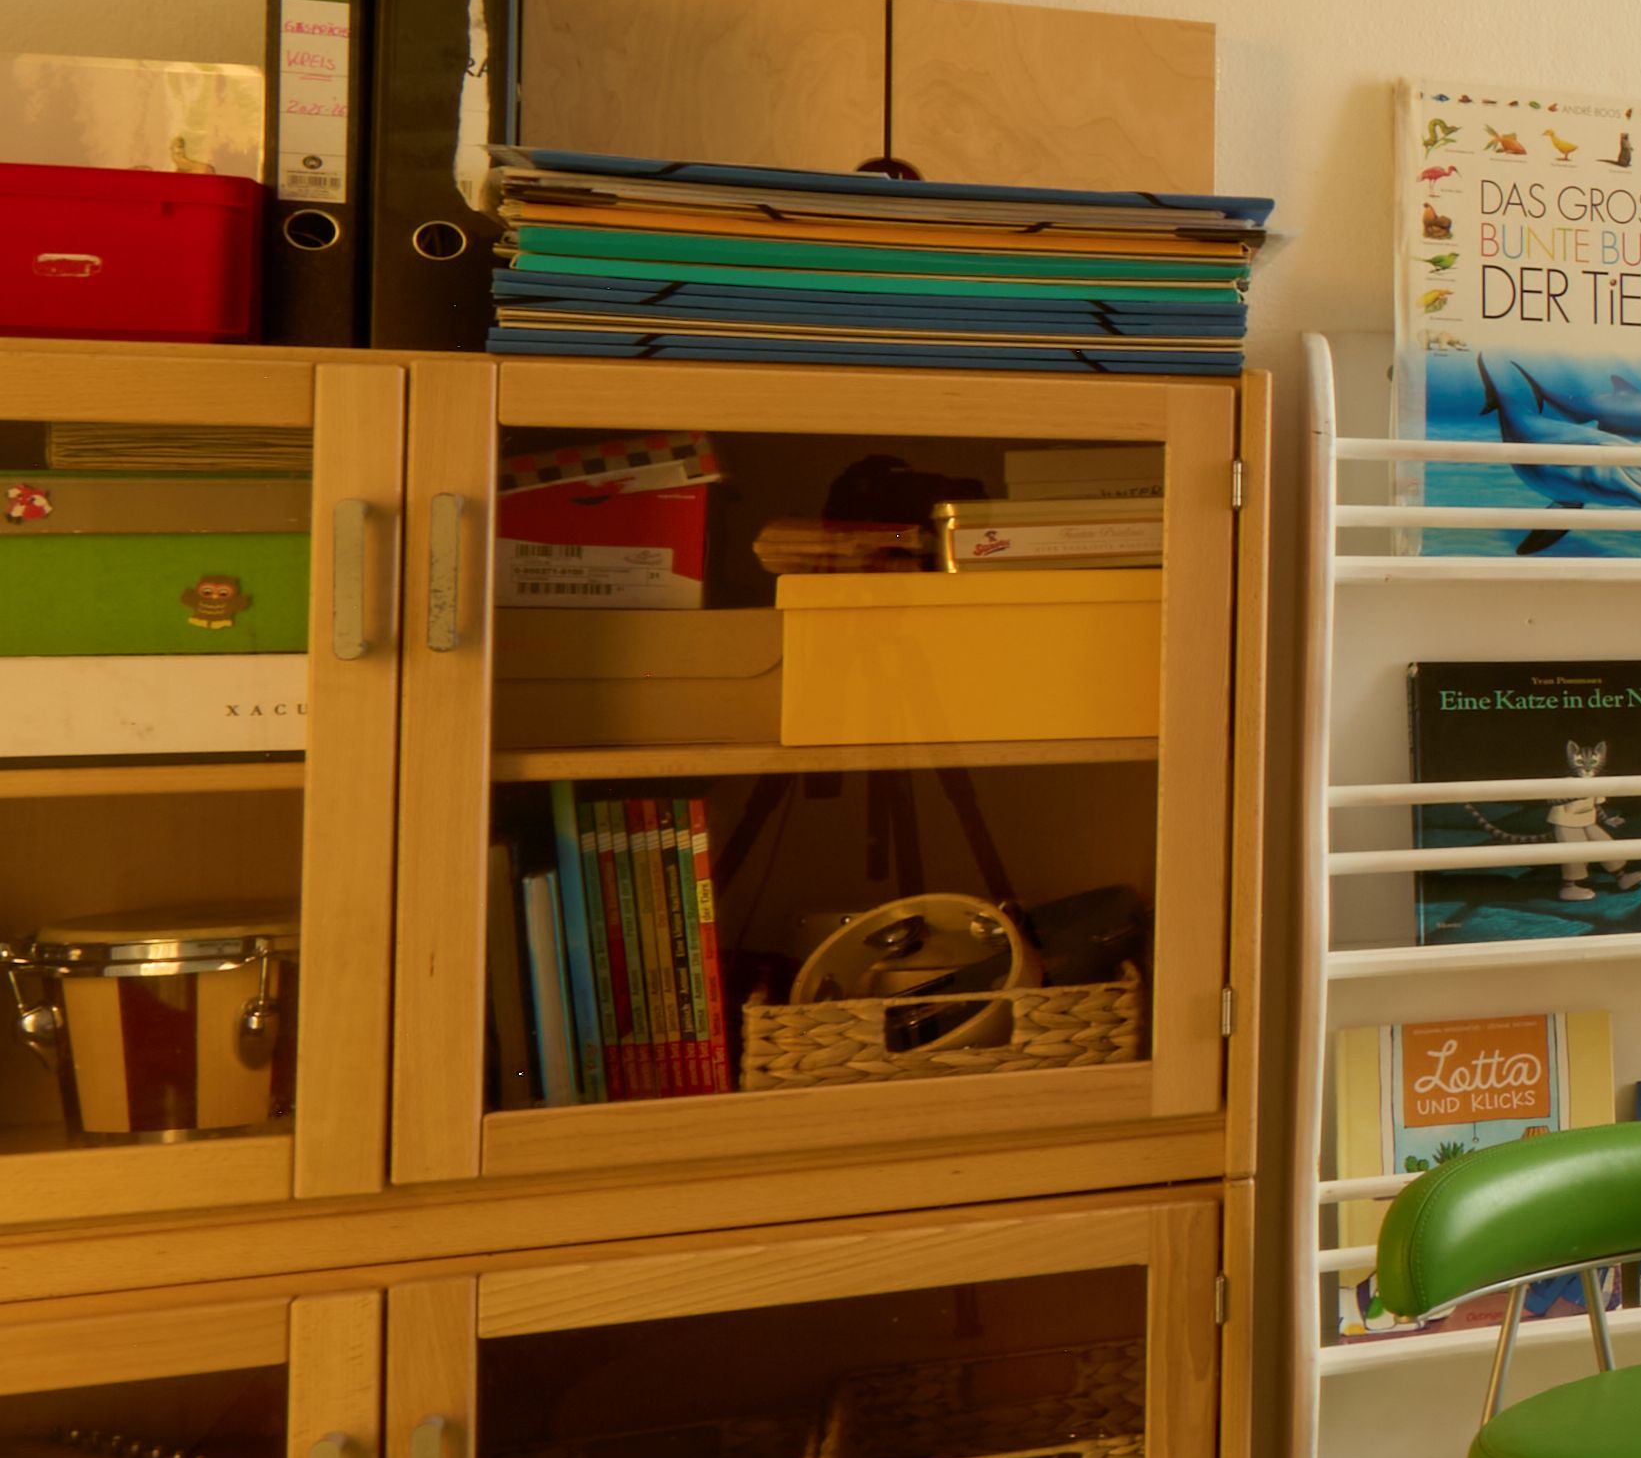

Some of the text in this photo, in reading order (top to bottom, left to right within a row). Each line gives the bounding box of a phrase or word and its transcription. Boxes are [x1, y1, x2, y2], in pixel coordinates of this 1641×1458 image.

[1562, 104, 1622, 119] ANDRÉ BOOS
[1480, 179, 1547, 219] DAS
[1480, 222, 1590, 263] BUNTE
[1482, 264, 1570, 324] DER
[1439, 691, 1491, 711] Eine
[1494, 689, 1559, 710] Katze
[1562, 689, 1583, 709] in
[1587, 688, 1624, 708] der
[1413, 1039, 1542, 1093] Lotta
[1416, 1090, 1536, 1115] UND KLICKS
